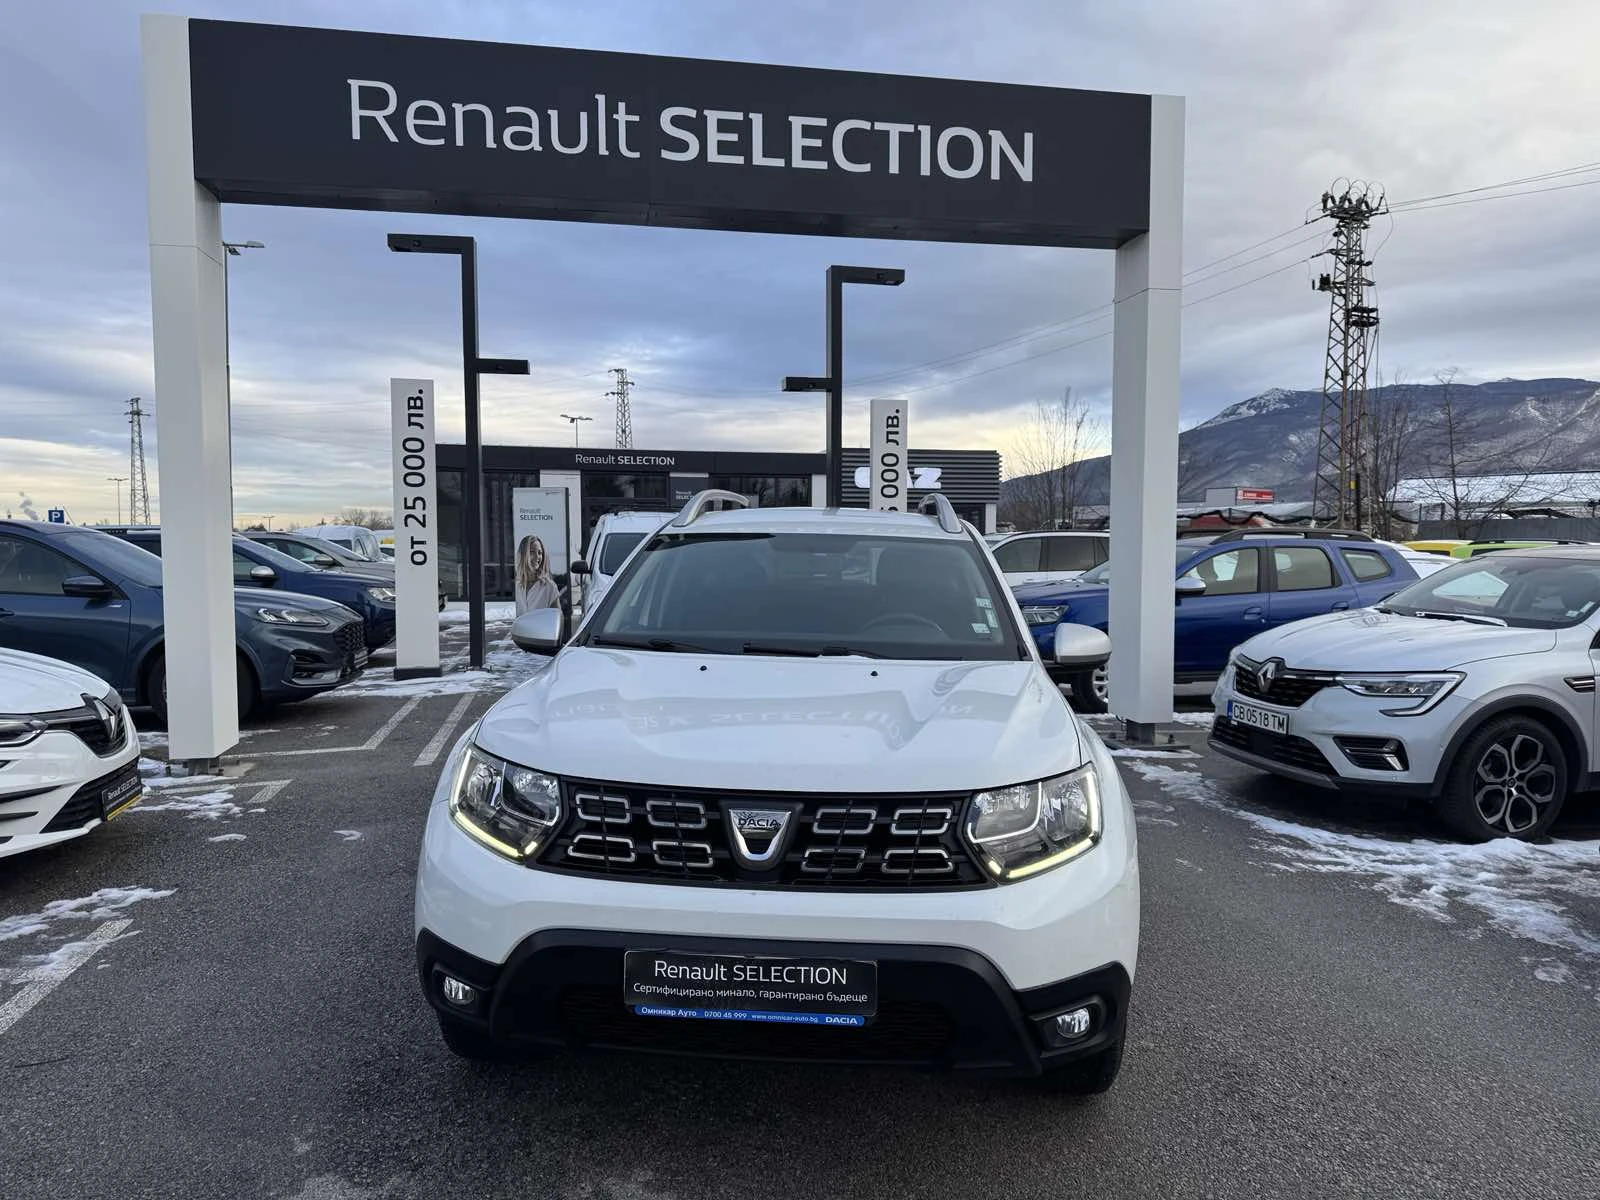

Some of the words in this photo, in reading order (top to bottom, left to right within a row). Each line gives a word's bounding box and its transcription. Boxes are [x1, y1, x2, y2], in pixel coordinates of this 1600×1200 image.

[347, 78, 641, 159] Renault
[659, 106, 1034, 182] SELECTION
[407, 389, 424, 429] лв.
[886, 408, 900, 446] лв.
[402, 436, 425, 488] 000
[575, 453, 615, 465] Renault
[617, 455, 675, 466] SELECTION
[404, 496, 426, 528] 25
[410, 536, 427, 566] от
[1233, 705, 1245, 720] CB
[1246, 708, 1270, 727] 0518
[1271, 714, 1286, 732] TM
[738, 818, 781, 827] DACIA
[654, 960, 728, 981] Renault
[733, 965, 847, 985] SELECTION
[633, 982, 714, 999] Сертифицирано
[715, 989, 757, 999] минало,
[759, 990, 825, 1003] гарантирано
[826, 992, 868, 1004] бъдеще
[641, 1006, 676, 1017] Омникар
[677, 1008, 697, 1018] Ауто
[703, 1010, 722, 1018] 0700
[825, 1016, 858, 1025] DACIA
